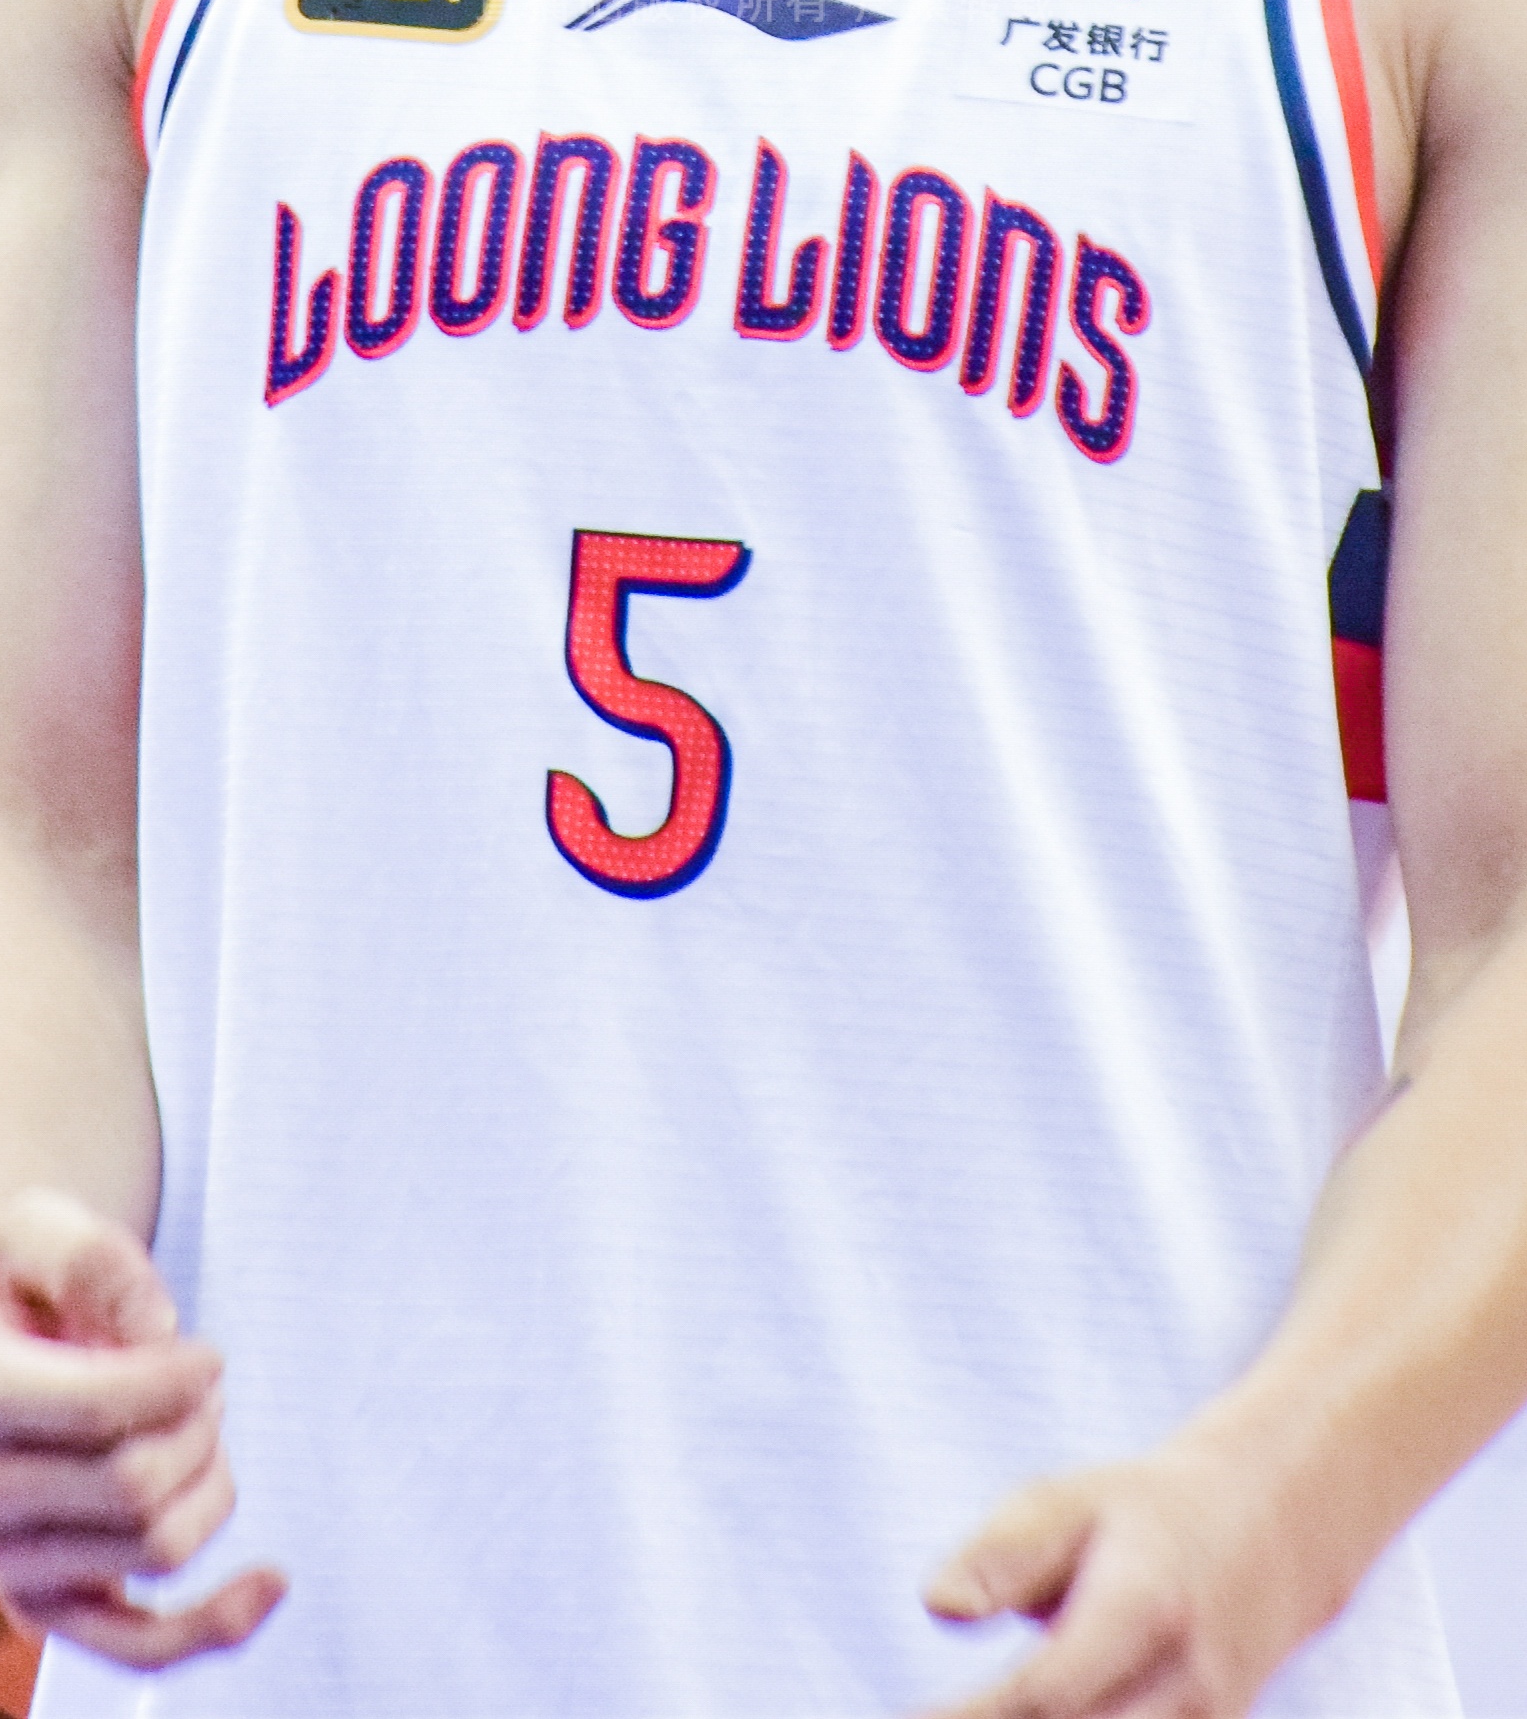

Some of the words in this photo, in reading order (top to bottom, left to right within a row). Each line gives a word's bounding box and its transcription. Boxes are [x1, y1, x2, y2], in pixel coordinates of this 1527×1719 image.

[1000, 17, 1170, 62] 广发银行
[1030, 62, 1129, 103] CGB
[264, 131, 716, 406] LOONG
[734, 138, 1149, 465] LIONS
[545, 528, 753, 900] 5
